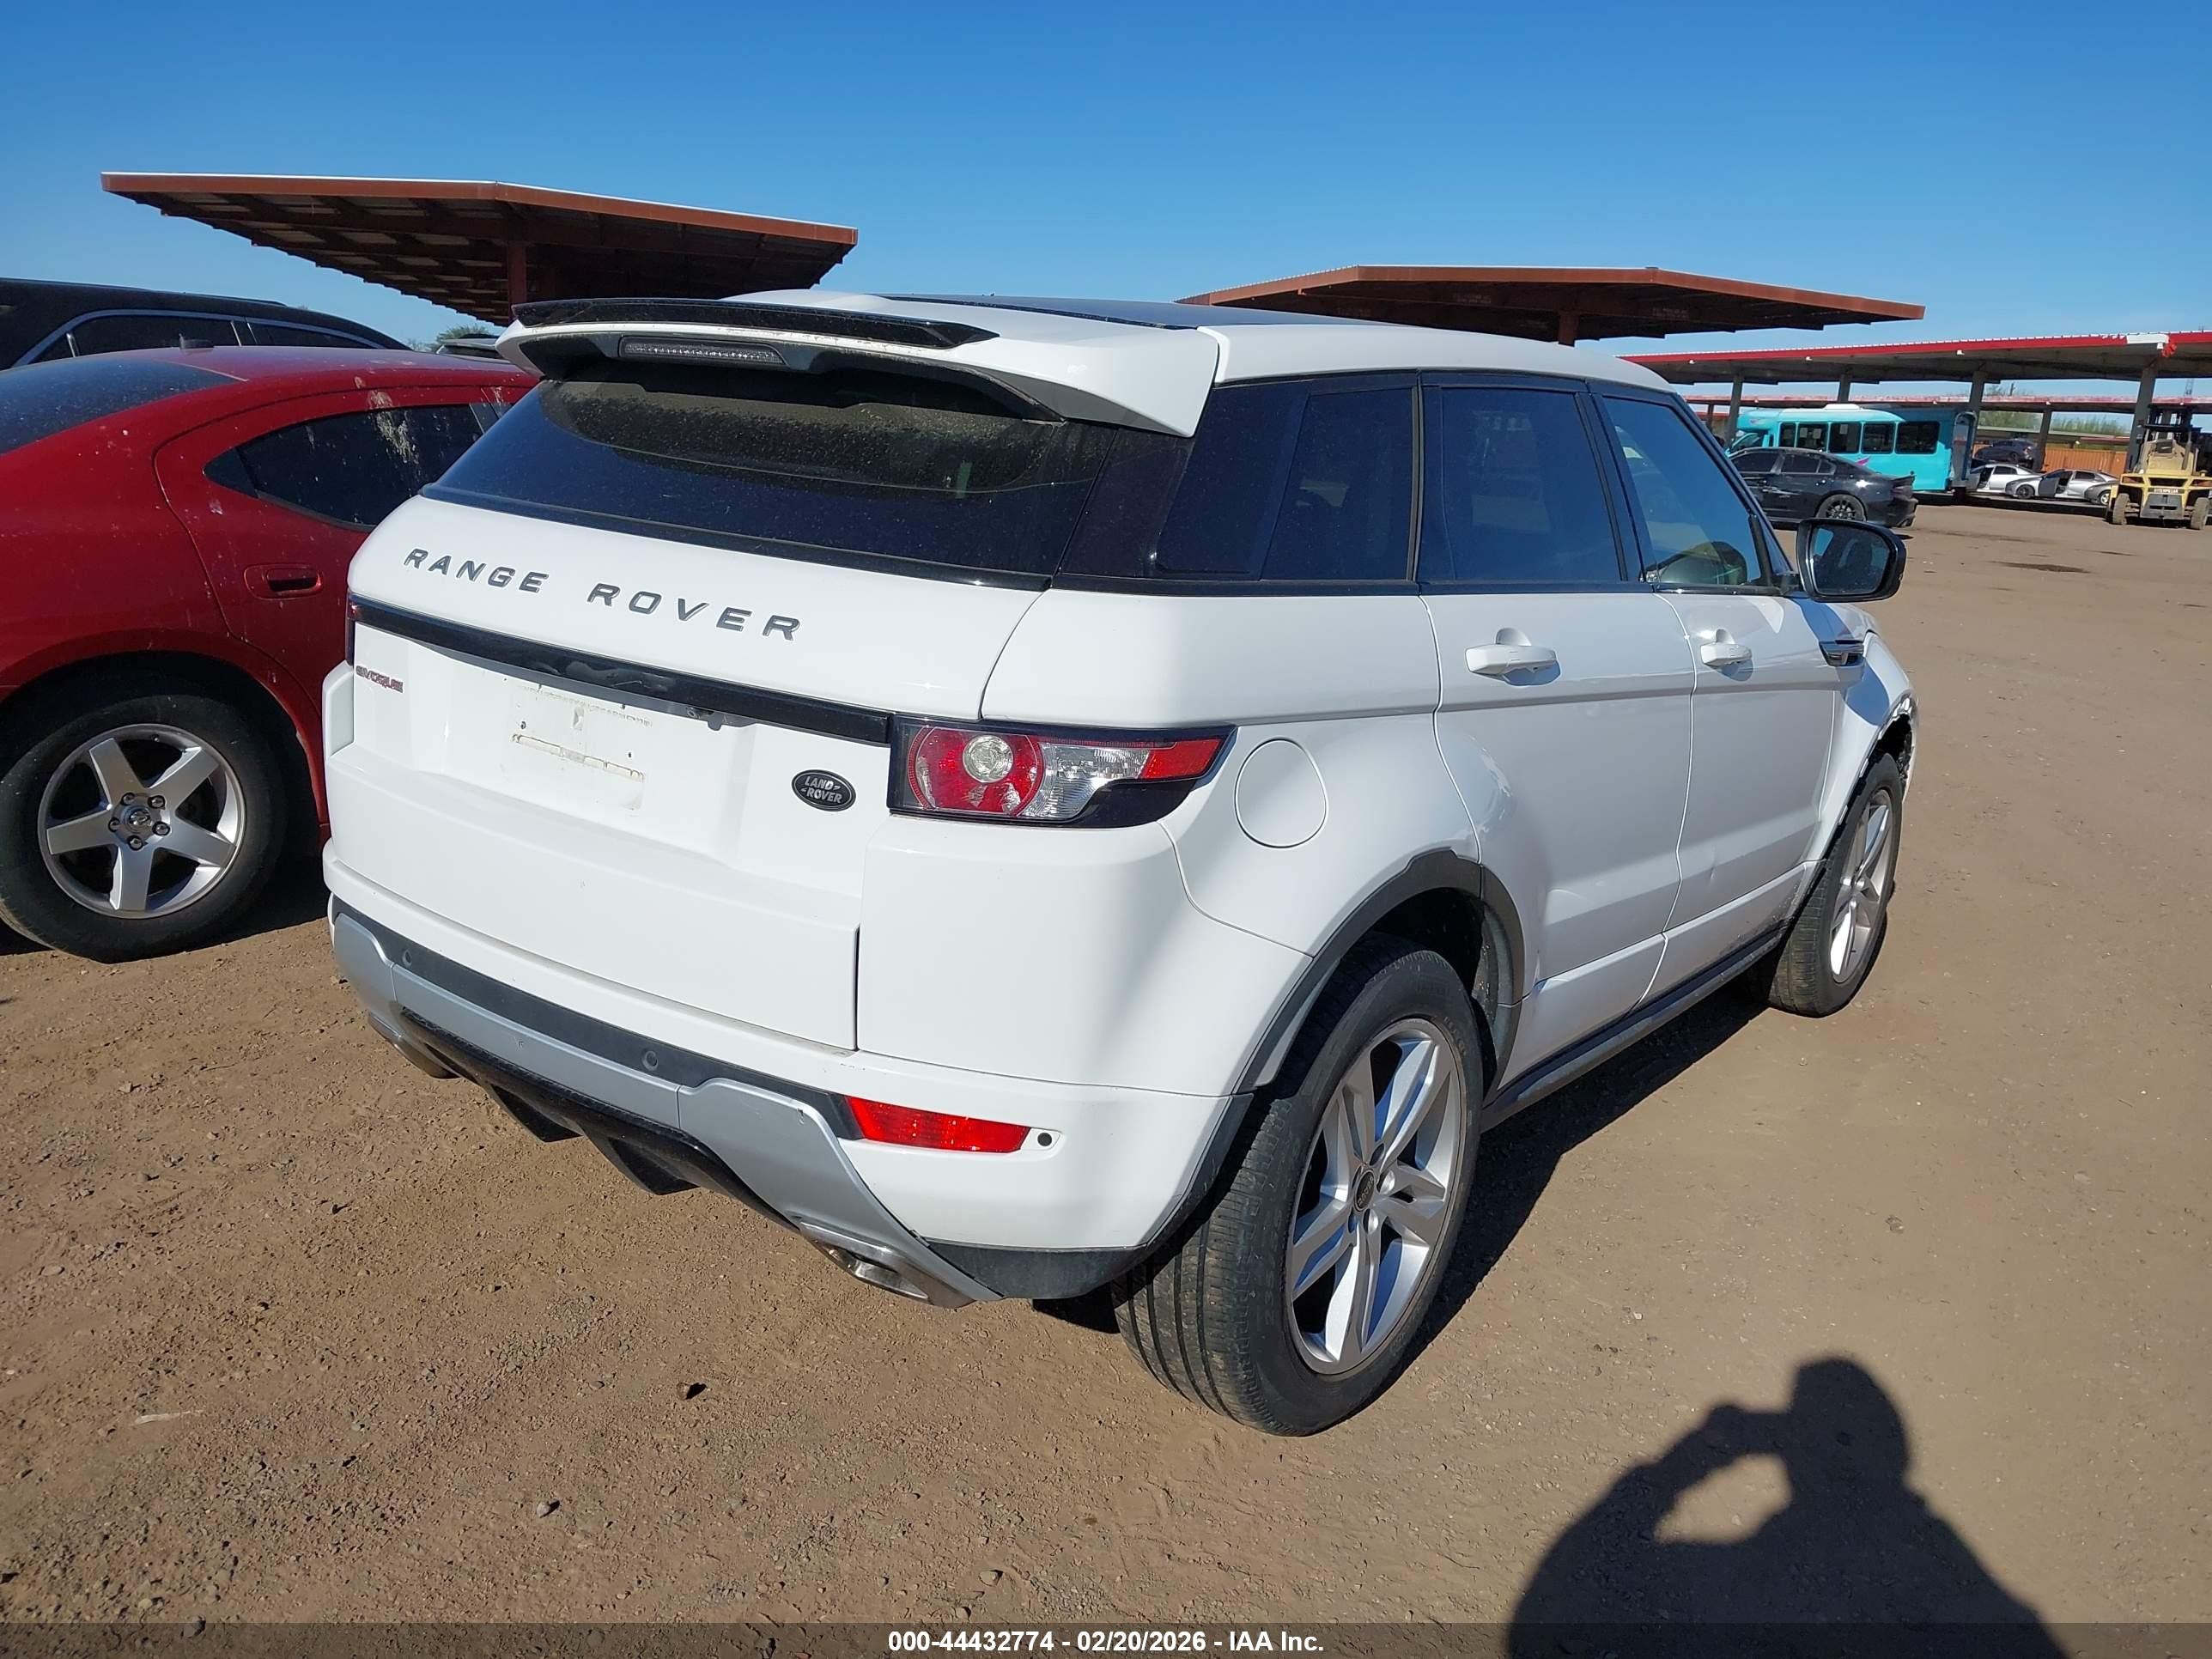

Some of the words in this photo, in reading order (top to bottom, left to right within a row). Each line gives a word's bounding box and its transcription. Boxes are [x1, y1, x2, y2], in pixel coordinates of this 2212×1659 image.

[404, 548, 550, 593] RANGE
[586, 582, 800, 641] ROVER
[804, 775, 834, 791] LAND
[806, 787, 842, 804] ROVER
